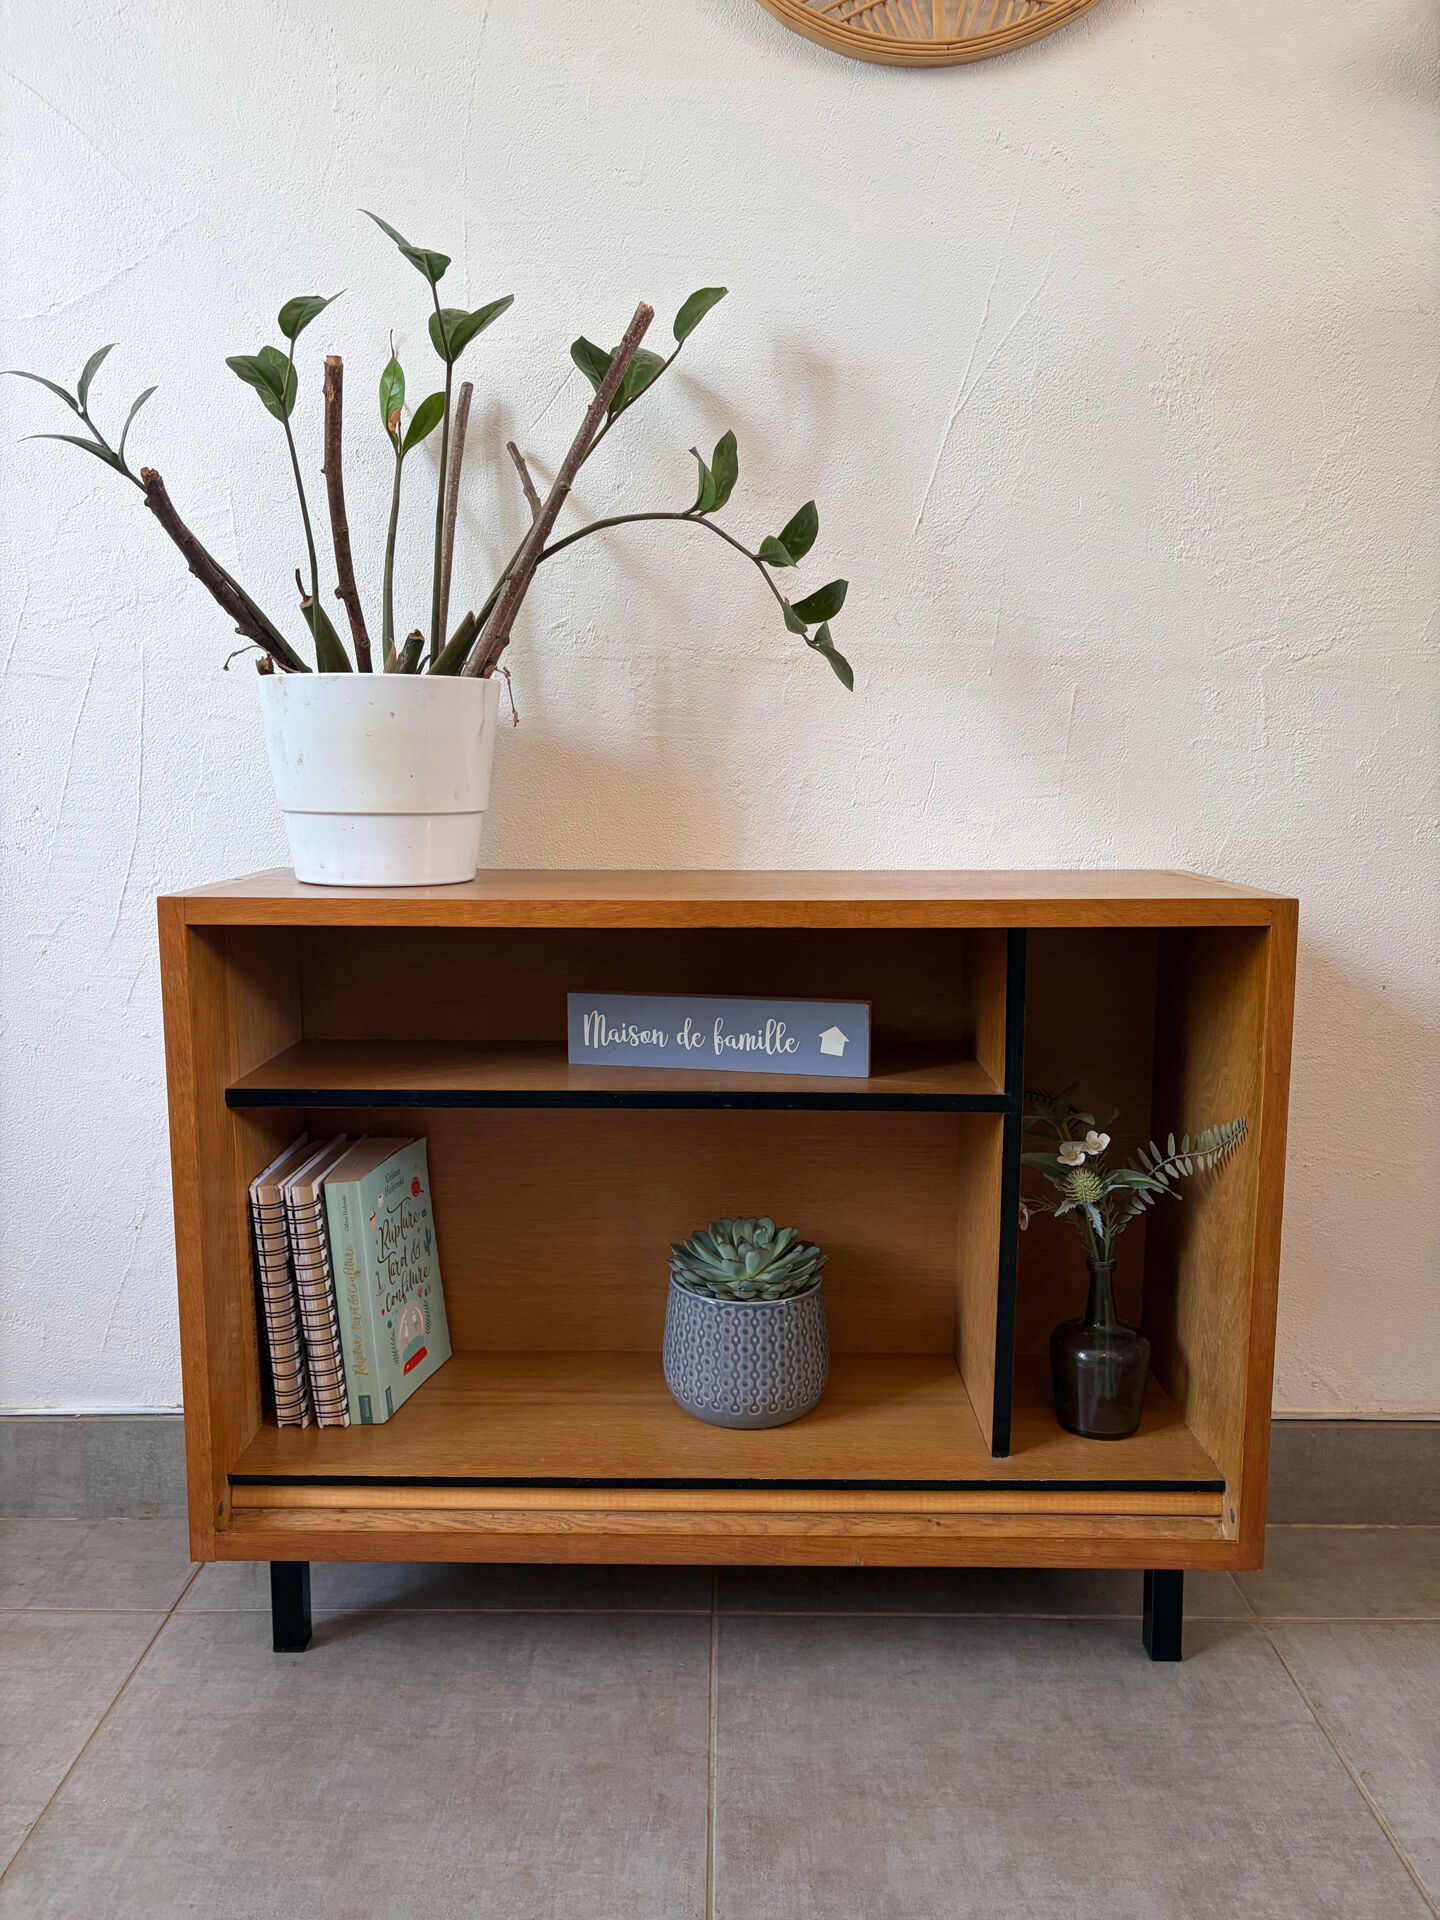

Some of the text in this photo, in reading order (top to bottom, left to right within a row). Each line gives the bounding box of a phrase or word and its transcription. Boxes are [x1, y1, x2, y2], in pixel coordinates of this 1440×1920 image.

[583, 1009, 800, 1056] Maison de famille
[377, 1238, 421, 1285] Tarot &
